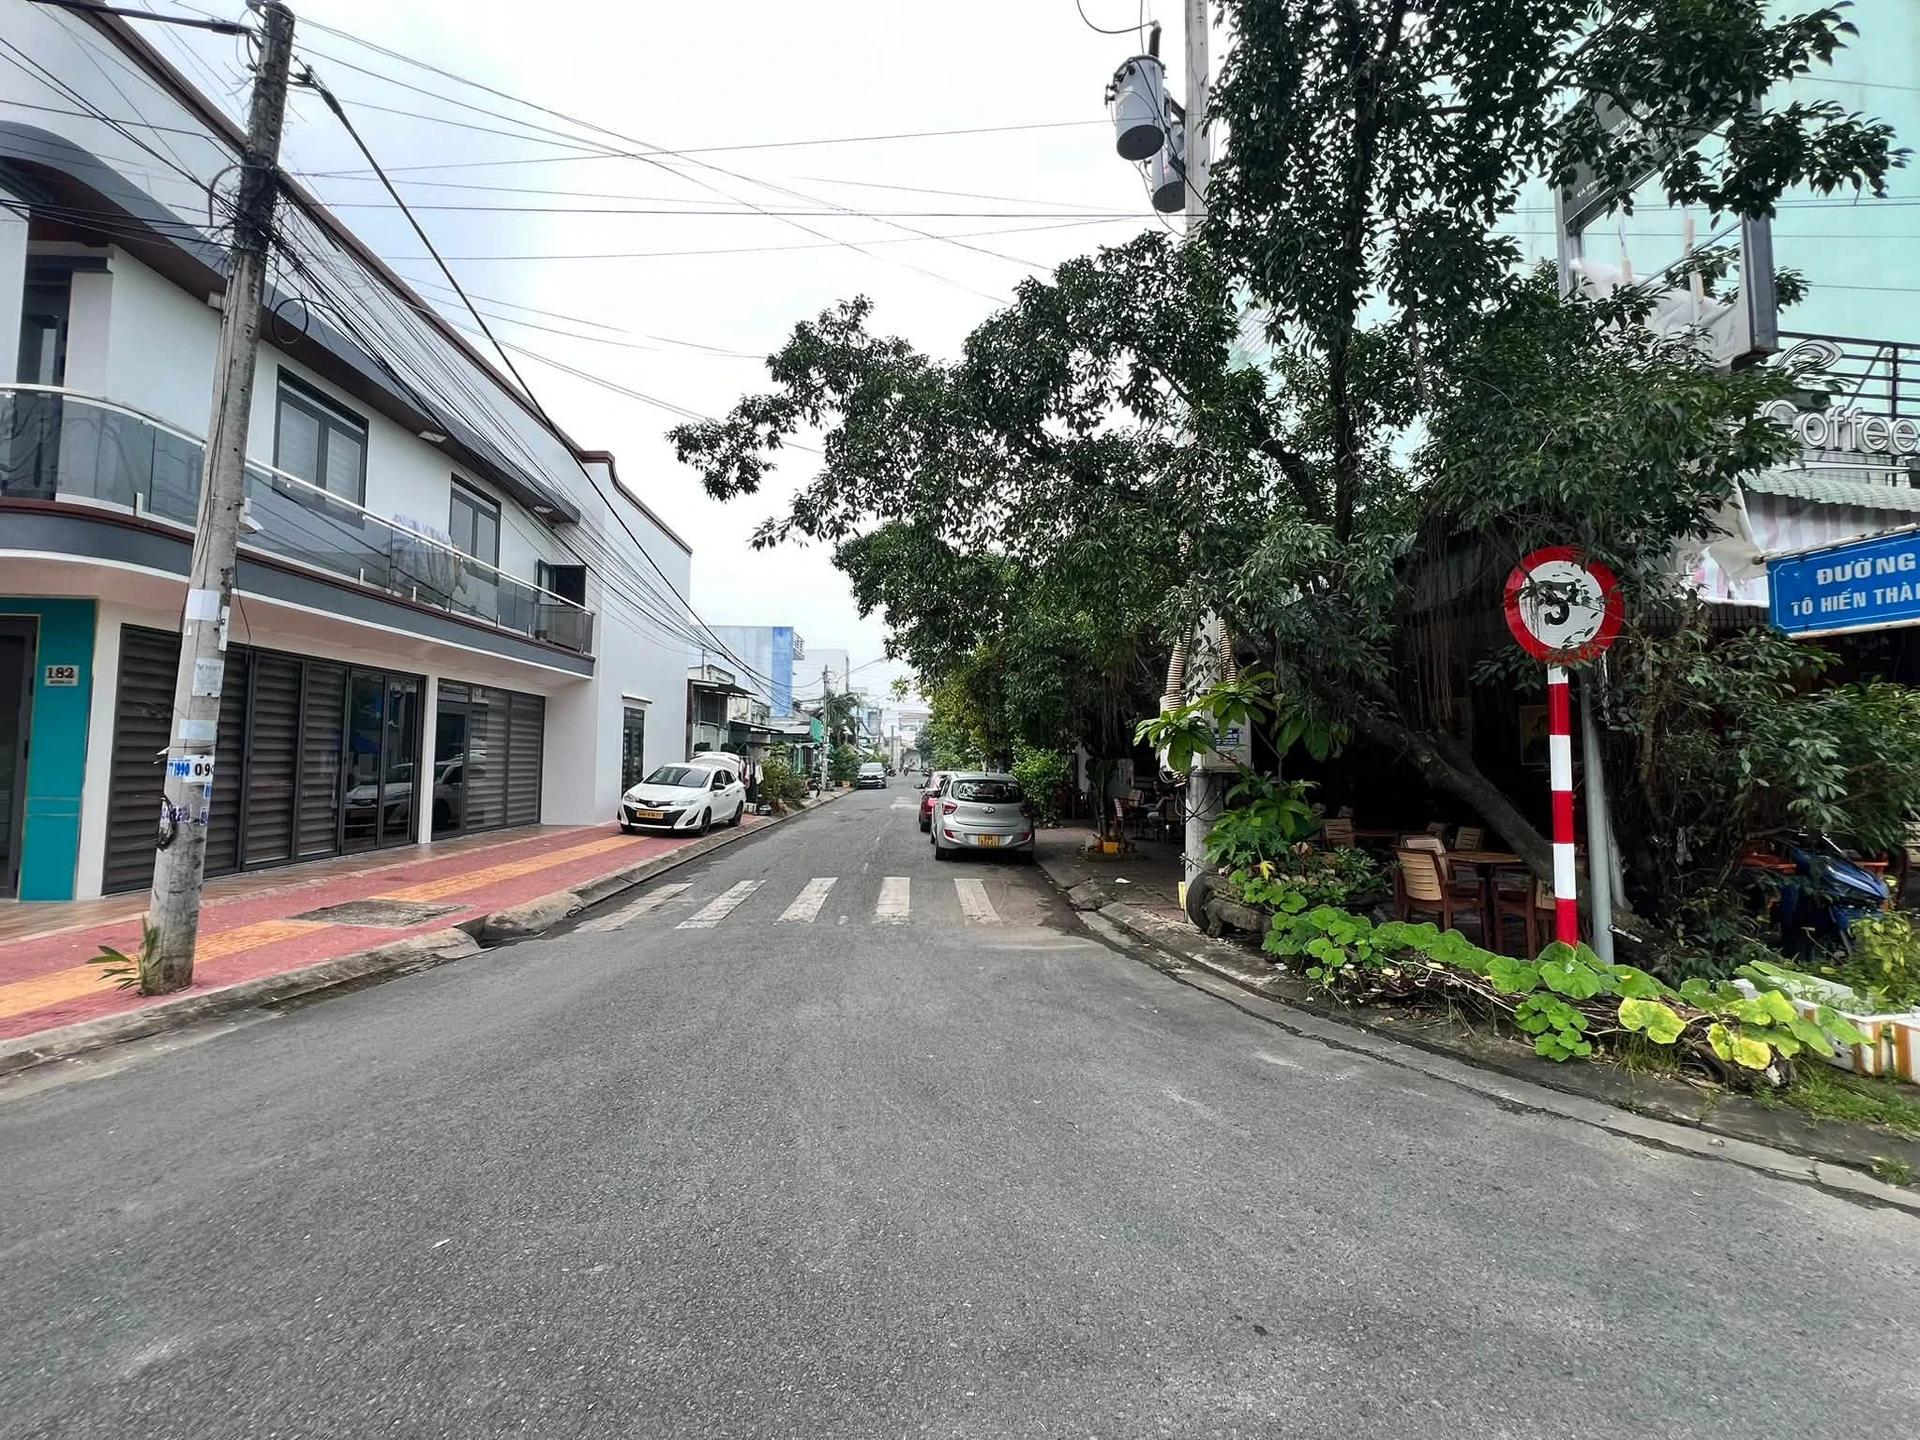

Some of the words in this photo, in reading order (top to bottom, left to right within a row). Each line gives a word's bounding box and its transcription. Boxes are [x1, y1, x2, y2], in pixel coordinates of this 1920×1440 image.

[1763, 399, 1919, 455] Coffee
[1815, 552, 1917, 585] ĐƯỜNG
[1790, 596, 1814, 616] TÔ
[1820, 587, 1867, 613] HIẾN
[1872, 581, 1920, 605] THÀ
[46, 667, 75, 679] 182
